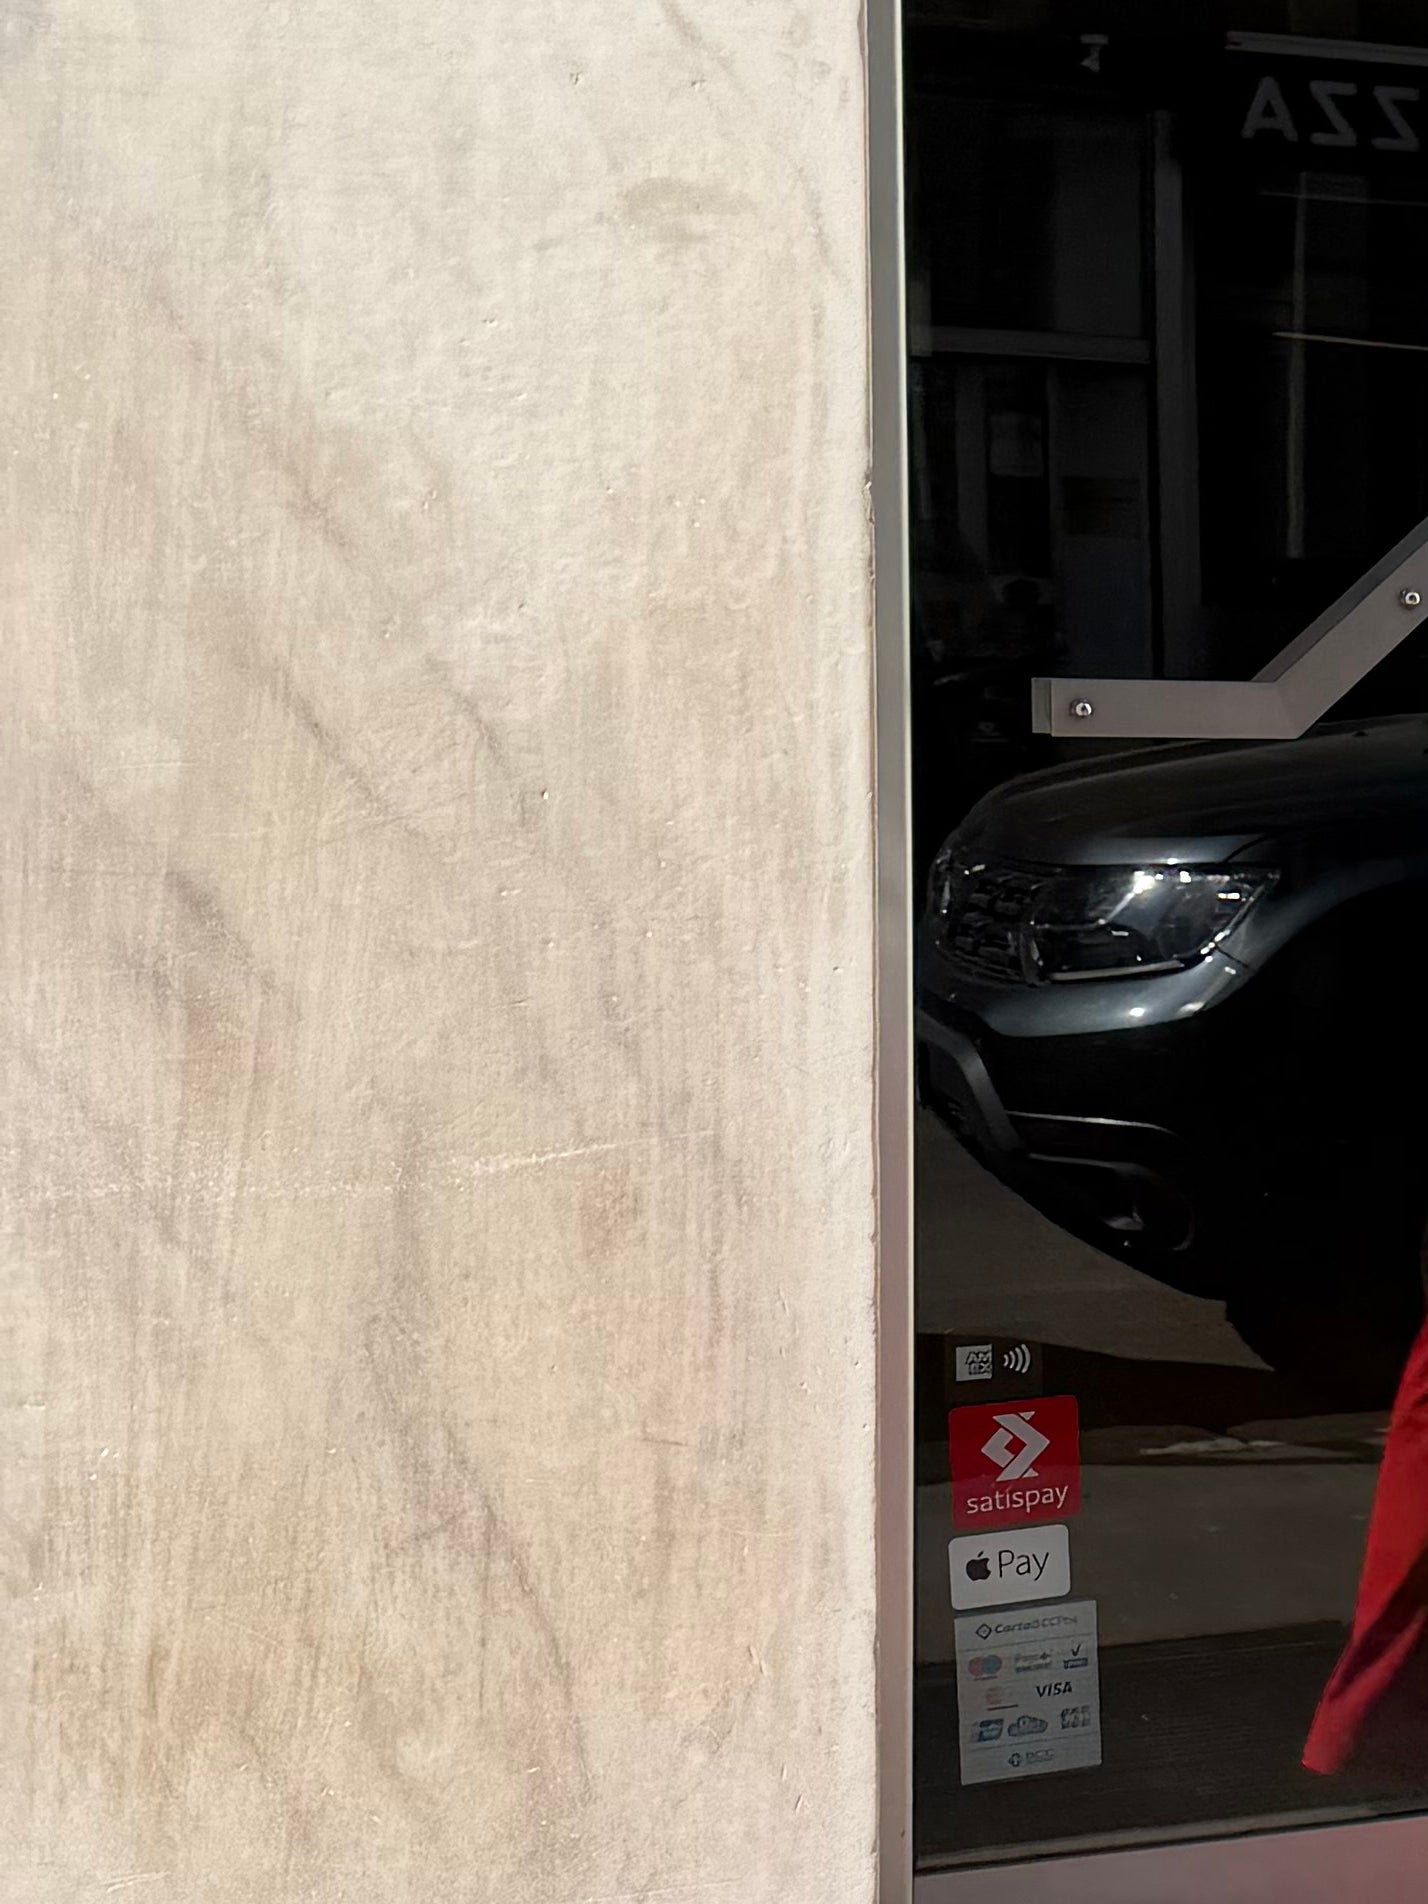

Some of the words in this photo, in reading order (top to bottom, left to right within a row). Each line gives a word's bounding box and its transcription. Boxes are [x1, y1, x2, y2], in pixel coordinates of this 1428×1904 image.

[967, 1485, 1069, 1514] satispay
[998, 1549, 1050, 1581] Pay
[1036, 1681, 1073, 1698] VISA
